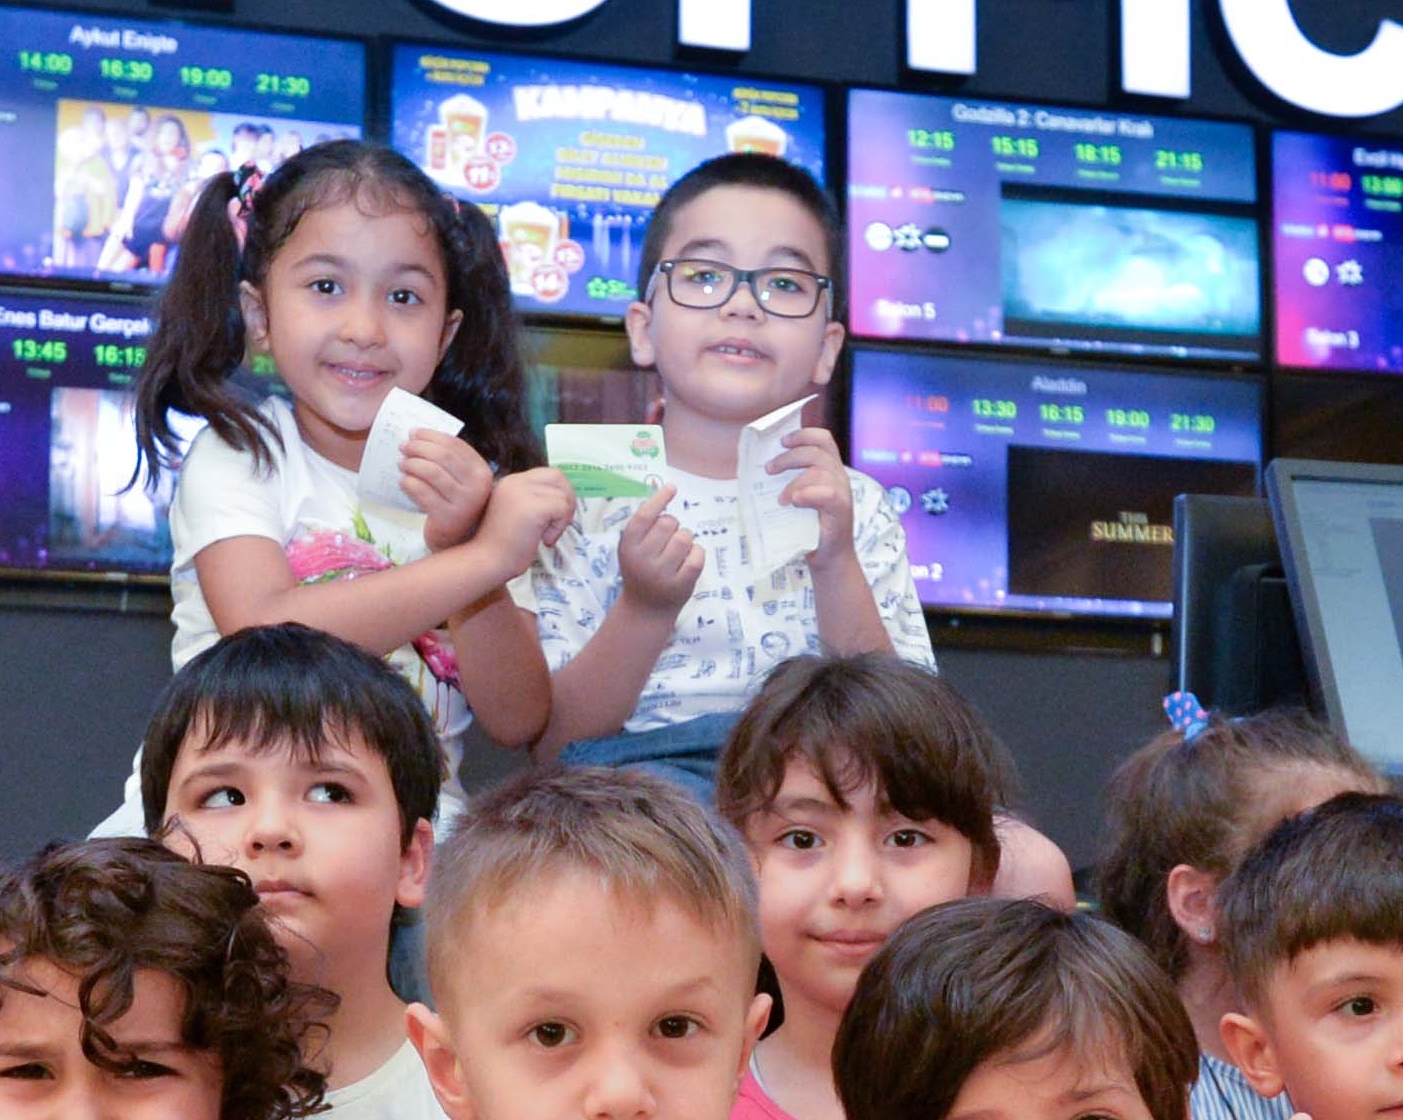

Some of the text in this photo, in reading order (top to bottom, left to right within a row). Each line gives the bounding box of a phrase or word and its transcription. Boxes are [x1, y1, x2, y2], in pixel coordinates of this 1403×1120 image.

[20, 50, 72, 74] 14:00
[100, 58, 153, 82] 16:30
[180, 66, 232, 89] 19:00
[256, 73, 309, 97] 21:30
[908, 129, 954, 150] 12:15
[992, 136, 1038, 158] 15:15
[1156, 150, 1202, 171] 21:15
[38, 309, 88, 332] Batur
[12, 339, 67, 363] 13:45
[1031, 375, 1087, 395] Aladdin
[973, 399, 1017, 420] 13:30
[1040, 404, 1084, 424] 16:15
[1106, 409, 1150, 429] 19:00
[1170, 413, 1215, 434] 21:30
[1091, 521, 1174, 544] SUMMER
